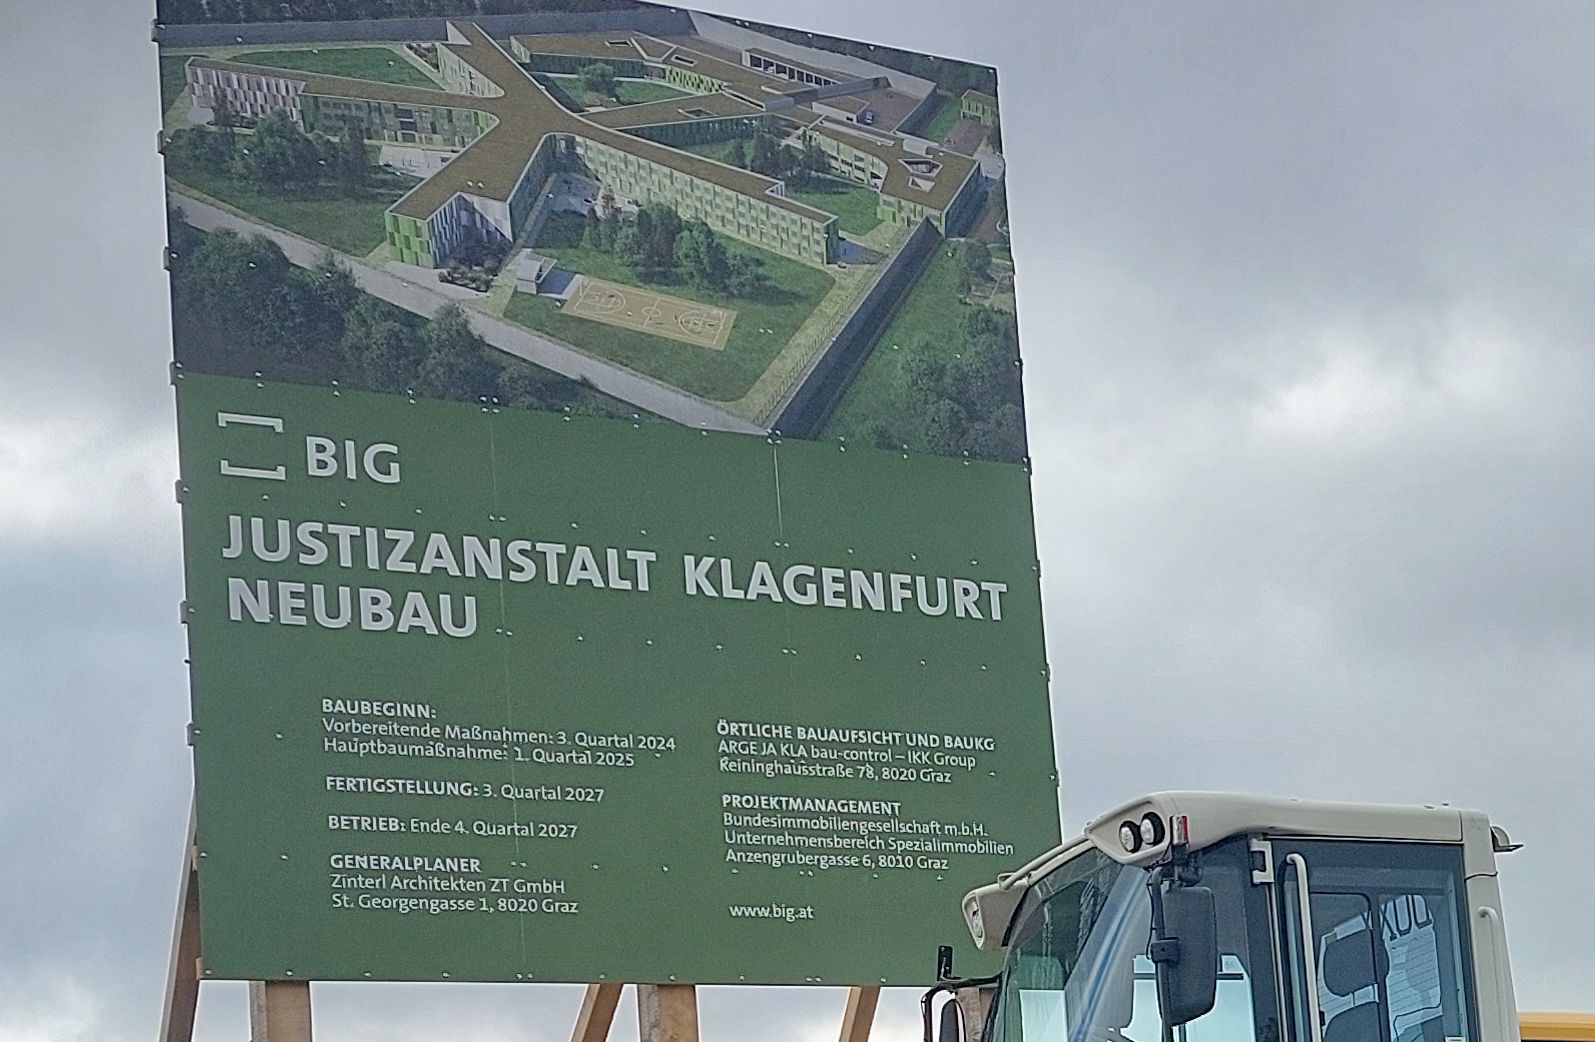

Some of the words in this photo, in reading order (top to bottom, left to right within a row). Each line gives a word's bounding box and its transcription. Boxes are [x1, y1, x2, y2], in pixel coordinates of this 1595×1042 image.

[306, 436, 401, 484] BIG
[222, 515, 656, 592] JUSTIZANSTALT
[683, 554, 1008, 621] KLAGENFURT
[227, 578, 478, 638] NEUBAU
[322, 699, 437, 719] BAUBEGINN:
[322, 718, 440, 739] Vorbereitende
[445, 725, 553, 745] Maßnahmen:
[557, 732, 572, 746] 3.
[575, 733, 633, 749] Quartal
[637, 736, 676, 751] 2024
[717, 718, 792, 739] ÖRTLICHE
[797, 726, 901, 746] BAUAUFSICHT
[906, 732, 939, 748] UND
[944, 735, 995, 751] BAUKG
[324, 738, 507, 761] Hauptbaumaßnahme:
[514, 746, 529, 762] 1.
[532, 748, 591, 765] Quartal
[595, 752, 634, 766] 2025
[718, 740, 757, 756] ARGE
[761, 741, 777, 756] JA
[780, 742, 807, 757] KLA
[811, 745, 892, 763] bau-control
[908, 751, 930, 765] IKK
[934, 752, 976, 771] Group
[720, 757, 854, 778] Reininghausstraße
[857, 764, 879, 781] 78,
[882, 767, 916, 781] 8020
[920, 769, 951, 783] Graz
[325, 776, 478, 796] FERTIGSTELLUNG:
[482, 783, 497, 798] 3.
[500, 784, 561, 800] Quartal
[565, 788, 604, 802] 2027
[722, 794, 901, 815] PROJEKTMANAGEMENT
[328, 815, 406, 832] BETRIEB:
[410, 818, 450, 834] Ende
[454, 821, 470, 834] 4.
[473, 821, 534, 838] Quartal
[538, 824, 577, 838] 2027
[723, 813, 941, 834] Bundesimmobiliengesellschaft
[944, 822, 988, 836] m.b.H.
[724, 830, 885, 850] Unternehmensbereich
[888, 837, 1014, 856] Spezialimmobilien
[330, 854, 481, 873] GENERALPLANER
[726, 849, 859, 869] Anzengrubergasse
[862, 854, 876, 869] 6,
[878, 855, 914, 869] 8010
[917, 855, 949, 870] Graz
[331, 874, 385, 890] Zinterl
[391, 875, 485, 892] Architekten
[490, 878, 509, 892] ZT
[514, 878, 565, 894] GmbH
[332, 893, 354, 908] St.
[358, 894, 474, 914] Georgengasse
[478, 898, 494, 913] 1,
[498, 898, 538, 913] 8020
[541, 898, 578, 913] Graz
[729, 903, 814, 921] www.big.at
